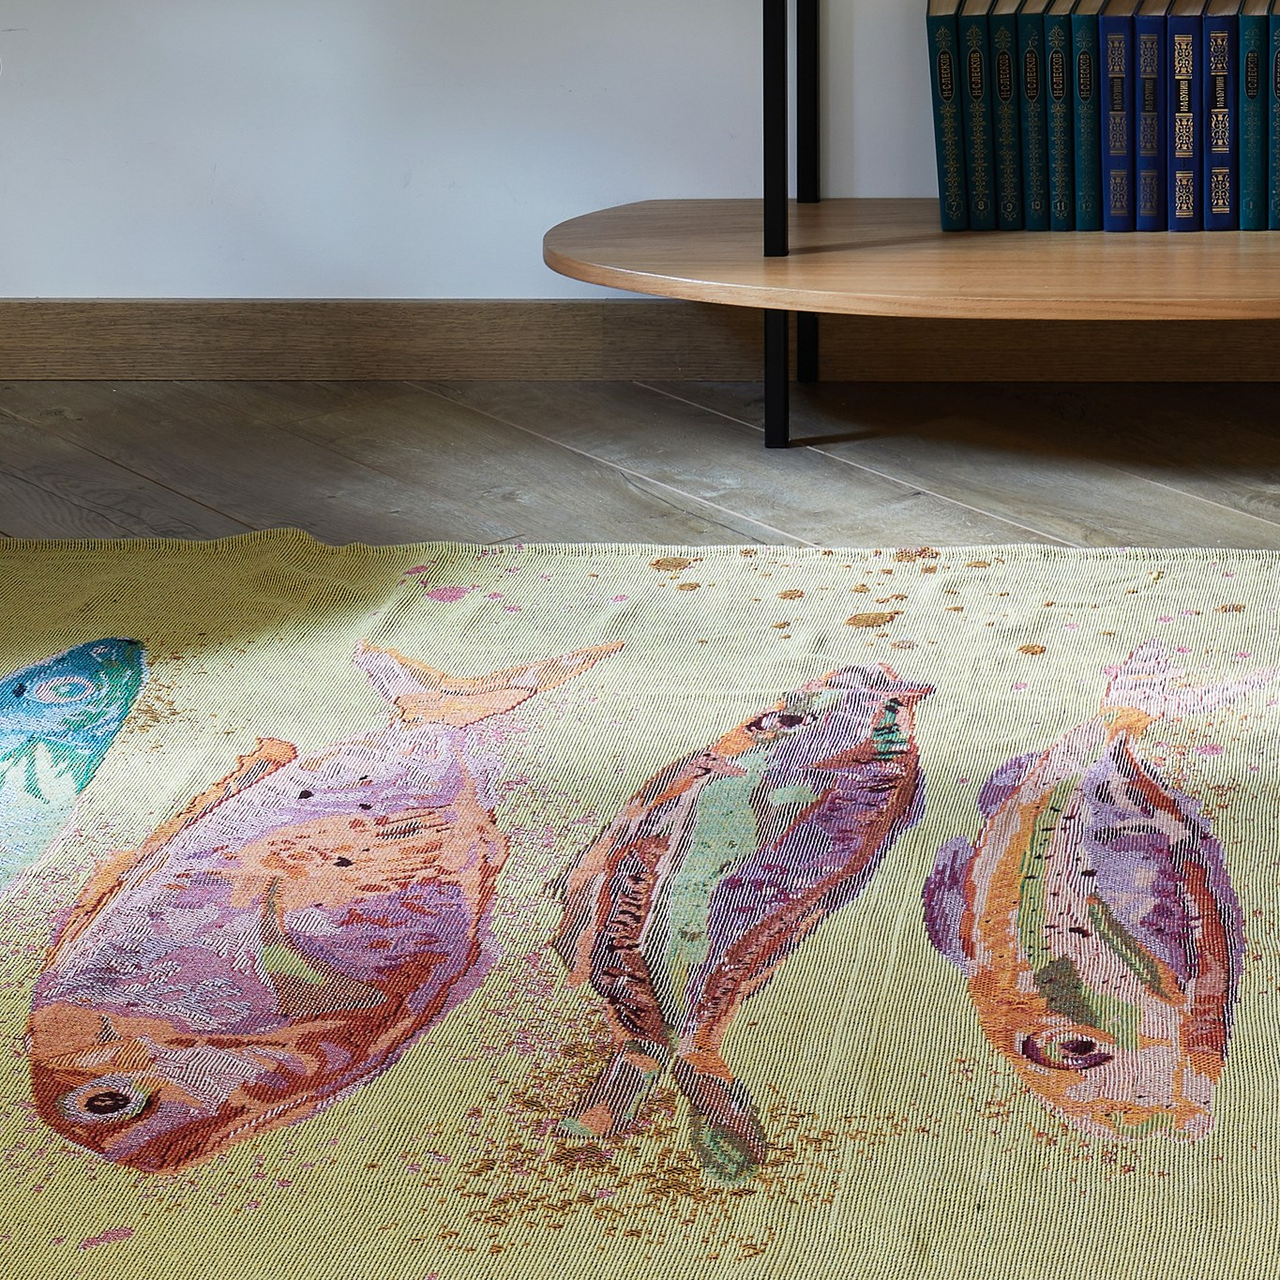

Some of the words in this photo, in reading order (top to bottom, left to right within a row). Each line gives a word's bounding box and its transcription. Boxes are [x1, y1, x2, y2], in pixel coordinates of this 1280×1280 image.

[951, 202, 958, 211] 7
[978, 201, 985, 211] 8
[1006, 203, 1013, 212] 9
[1031, 201, 1041, 210] 10
[1057, 202, 1064, 211] 11
[1082, 202, 1092, 211] 12
